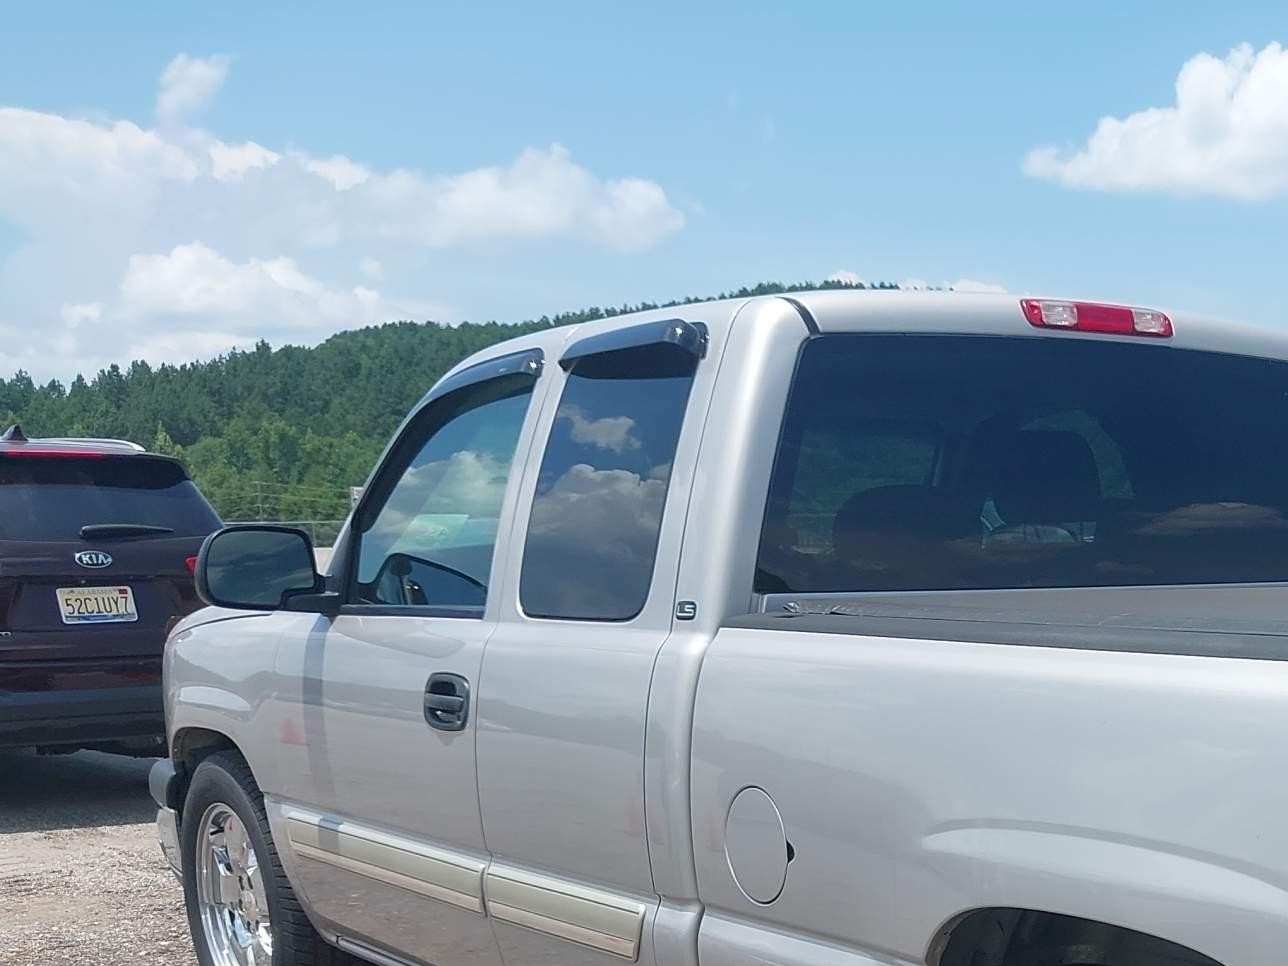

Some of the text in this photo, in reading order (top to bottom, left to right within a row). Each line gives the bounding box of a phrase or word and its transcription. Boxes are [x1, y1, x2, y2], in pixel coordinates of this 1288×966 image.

[80, 553, 111, 565] KIA
[65, 596, 129, 615] 52C1UY7
[676, 604, 695, 617] LS
